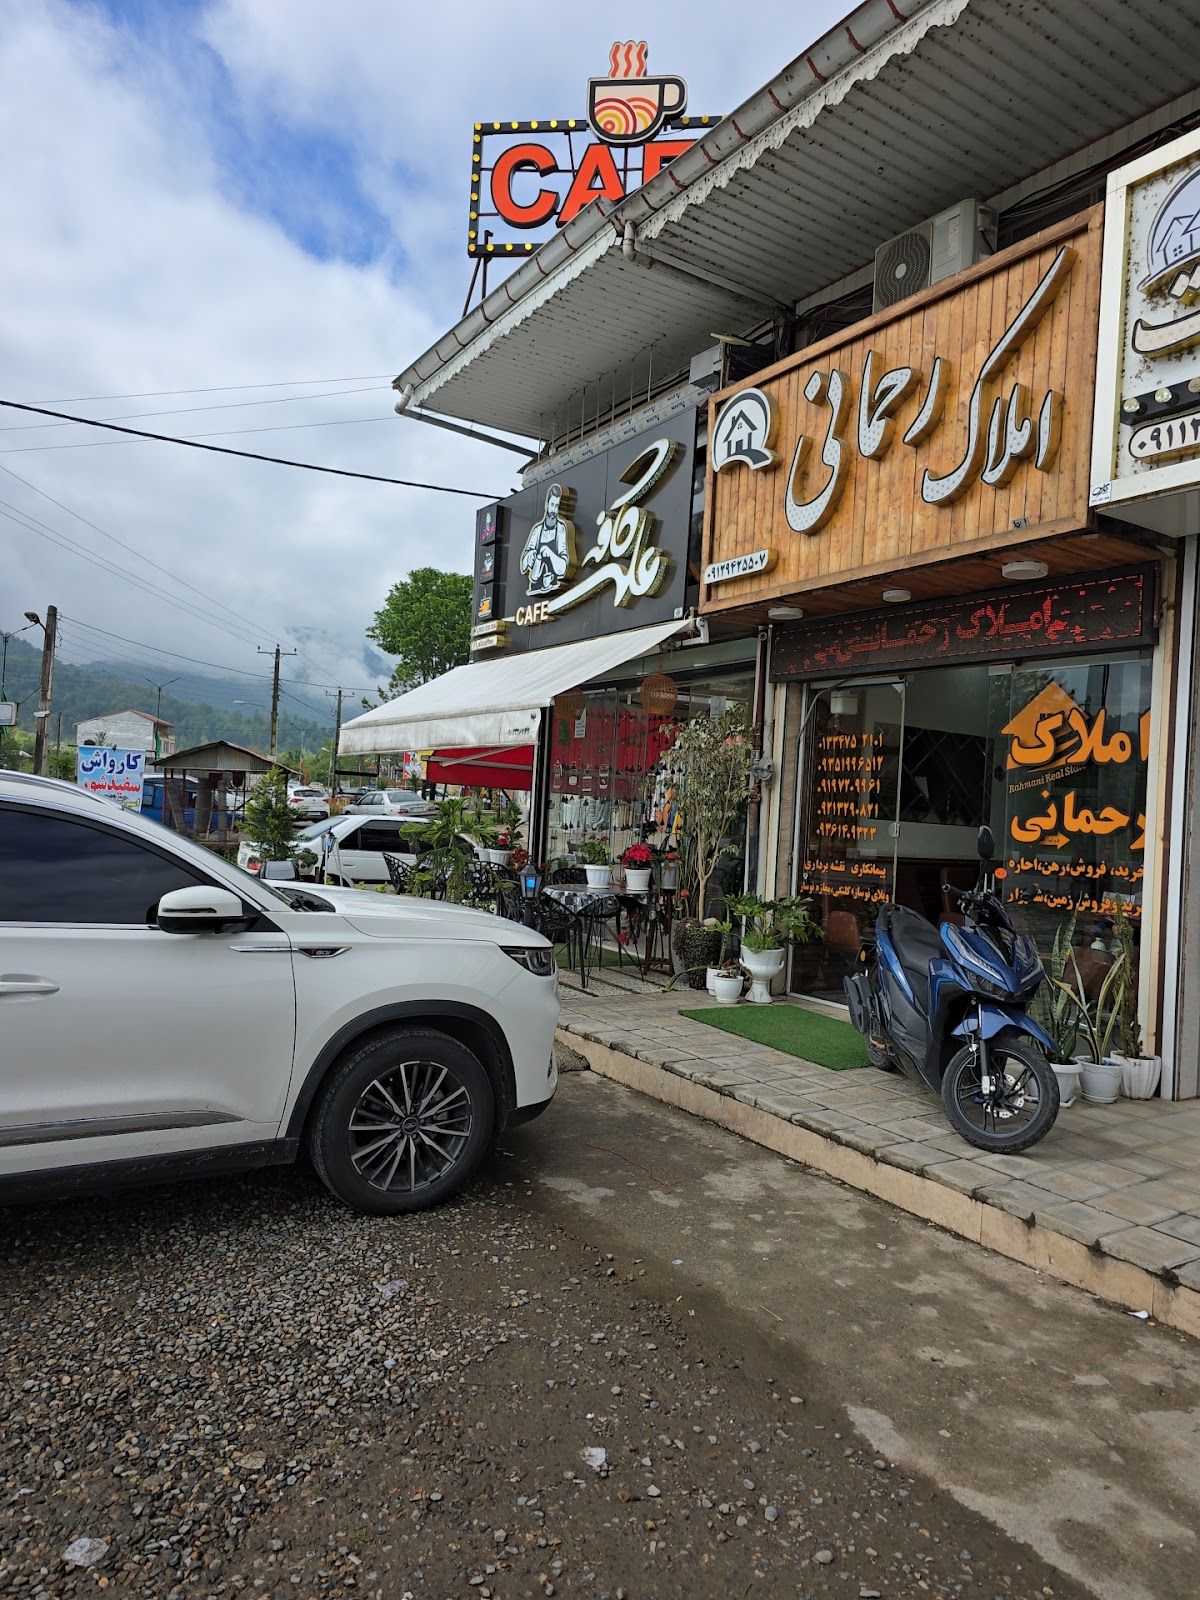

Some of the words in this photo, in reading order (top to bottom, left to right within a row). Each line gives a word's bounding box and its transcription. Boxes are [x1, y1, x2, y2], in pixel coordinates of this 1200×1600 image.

[921, 245, 1076, 506] املاک
[785, 349, 948, 535] رحمانی
[515, 600, 549, 627] CAFE
[81, 751, 142, 774] کارواش
[1008, 776, 1045, 794] Rahmani
[1045, 768, 1065, 783] Real
